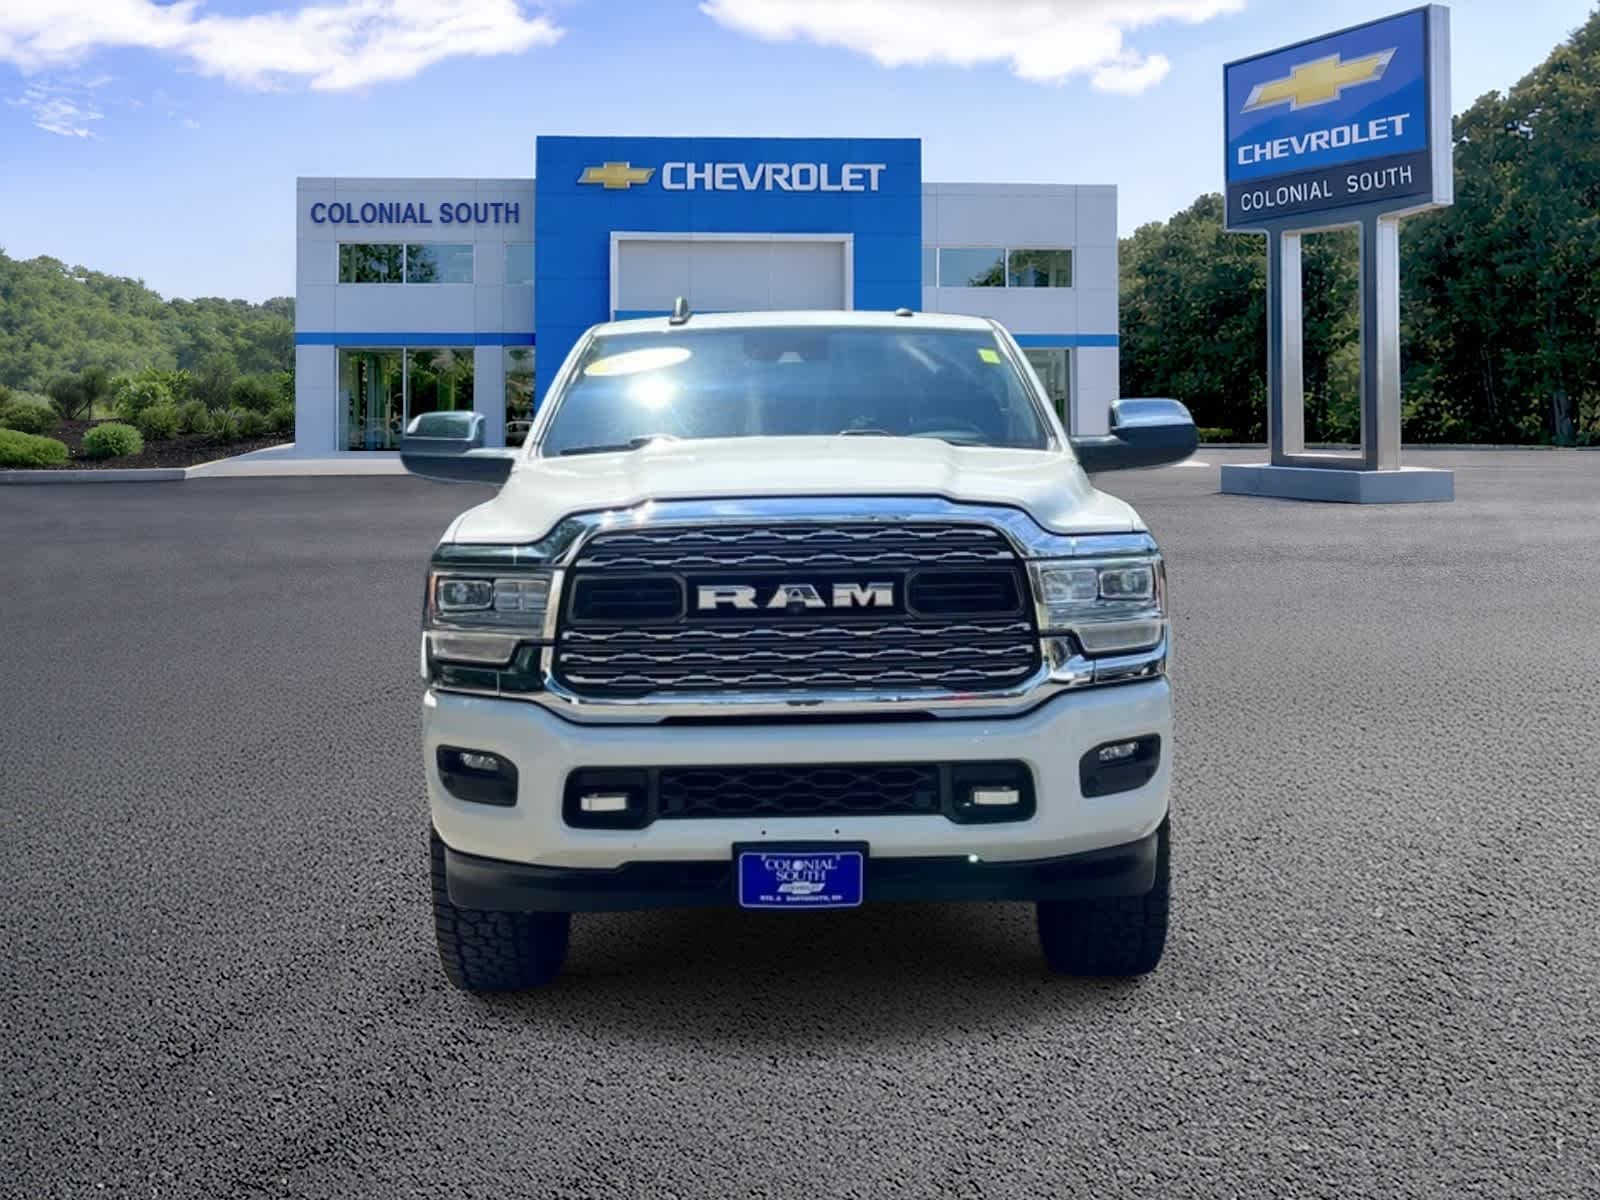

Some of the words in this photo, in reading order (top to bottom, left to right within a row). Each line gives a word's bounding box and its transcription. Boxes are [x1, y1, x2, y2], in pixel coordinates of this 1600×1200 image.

[1237, 113, 1410, 165] CHEVROLET
[661, 161, 887, 193] CHEVROLET
[1240, 179, 1333, 211] COLONIAL
[1346, 165, 1413, 193] SOUTH
[310, 202, 433, 225] COLONIAL
[439, 202, 520, 224] SOUTH
[697, 582, 894, 610] RAM
[764, 858, 837, 871] COLONIAL
[776, 870, 826, 881] SOUTH
